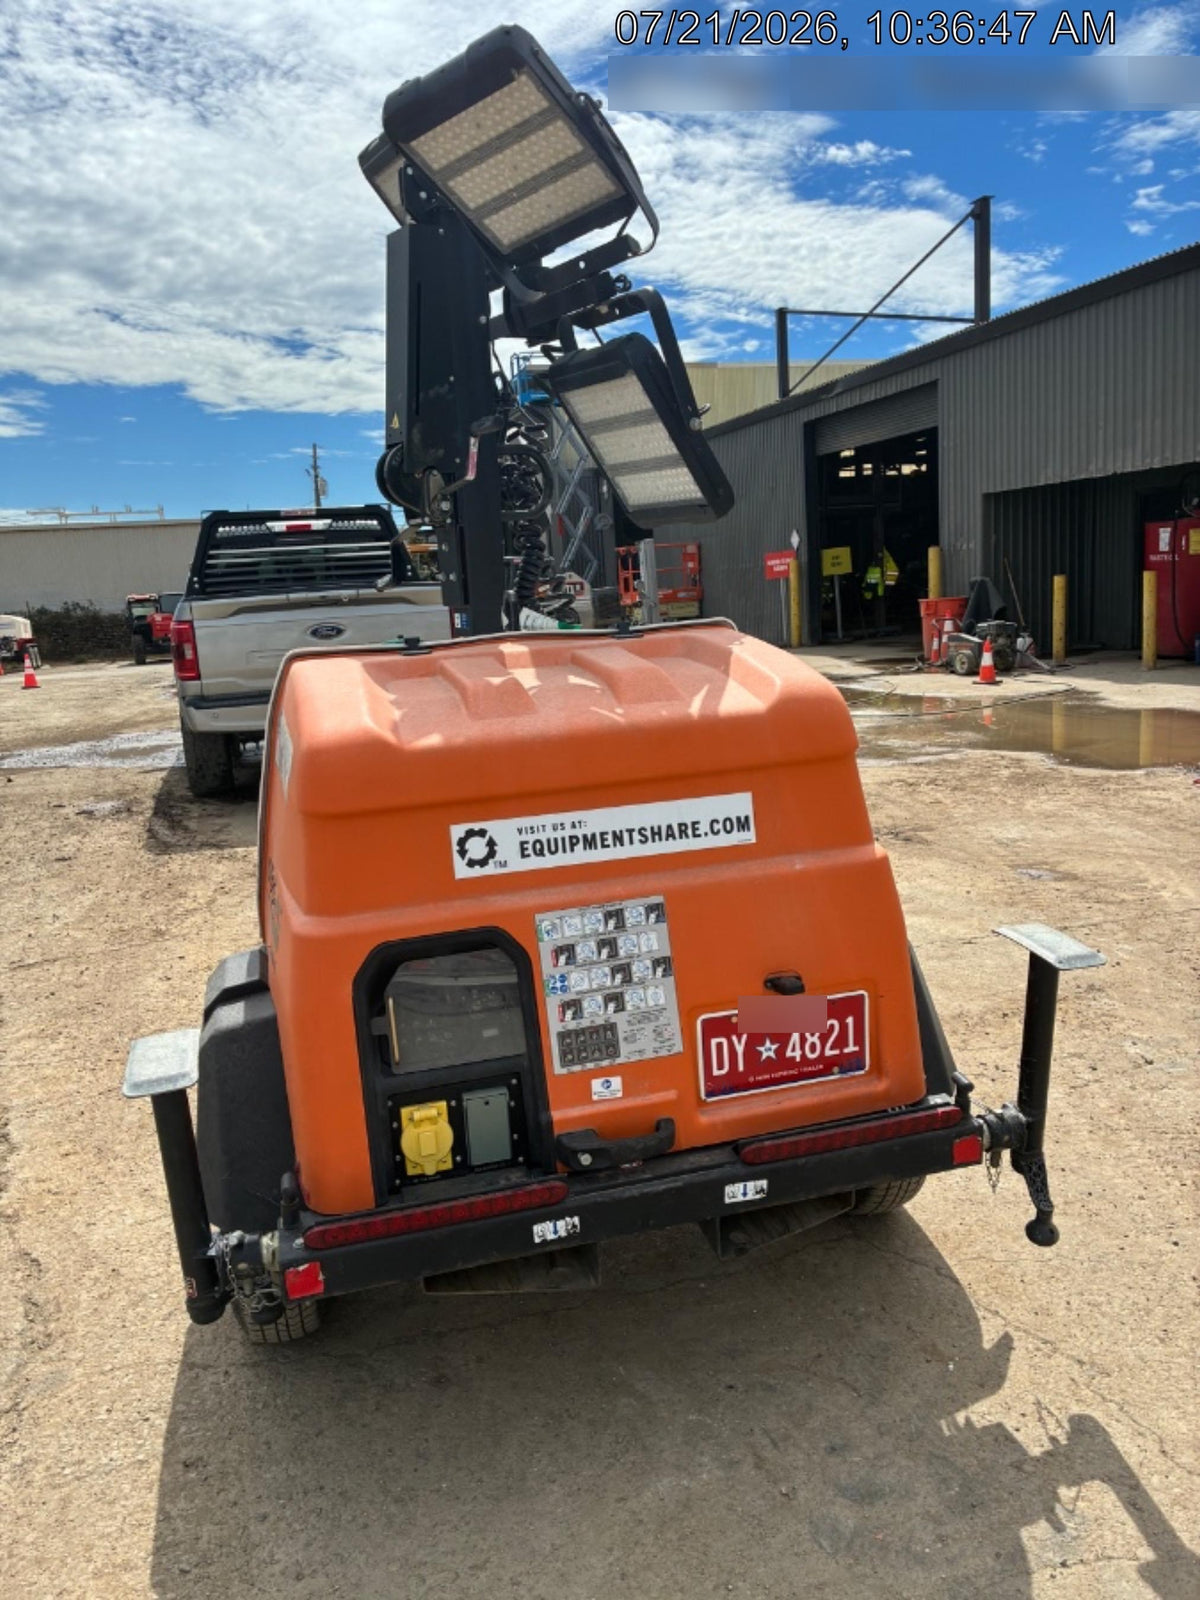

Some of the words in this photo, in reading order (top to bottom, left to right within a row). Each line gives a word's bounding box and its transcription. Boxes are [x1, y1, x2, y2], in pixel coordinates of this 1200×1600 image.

[516, 824, 547, 836] VISIT
[551, 822, 566, 832] US
[571, 820, 588, 830] AT:
[519, 815, 751, 860] EQUIPMENTSHARE.COM
[711, 1033, 748, 1076] DY
[785, 1016, 860, 1062] 4821
